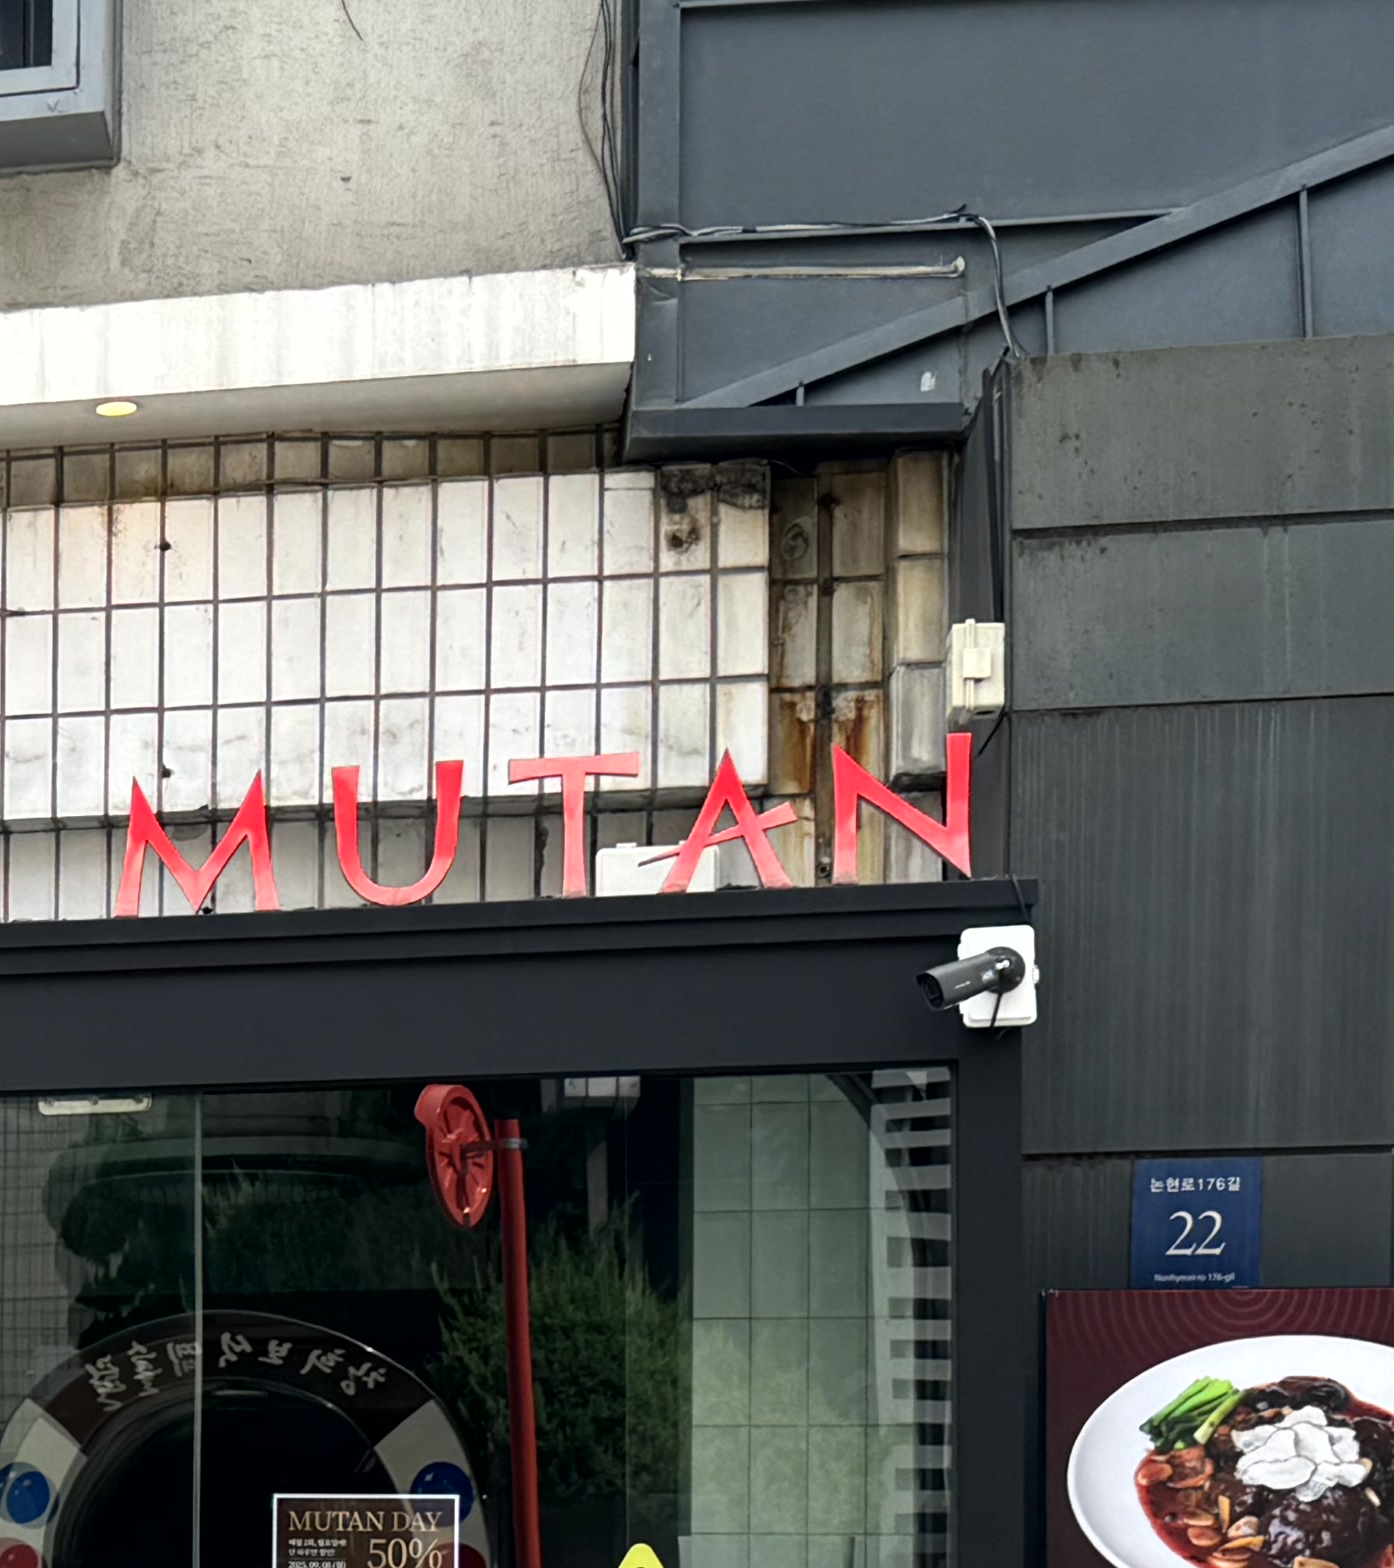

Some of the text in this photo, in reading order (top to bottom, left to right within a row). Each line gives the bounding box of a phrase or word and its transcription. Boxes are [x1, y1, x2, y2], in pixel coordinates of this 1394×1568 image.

[115, 733, 972, 917] MUTAN
[1150, 1177, 1240, 1192] 논현로176길
[1165, 1211, 1226, 1255] 22
[289, 1511, 443, 1532] MUTAN DAY
